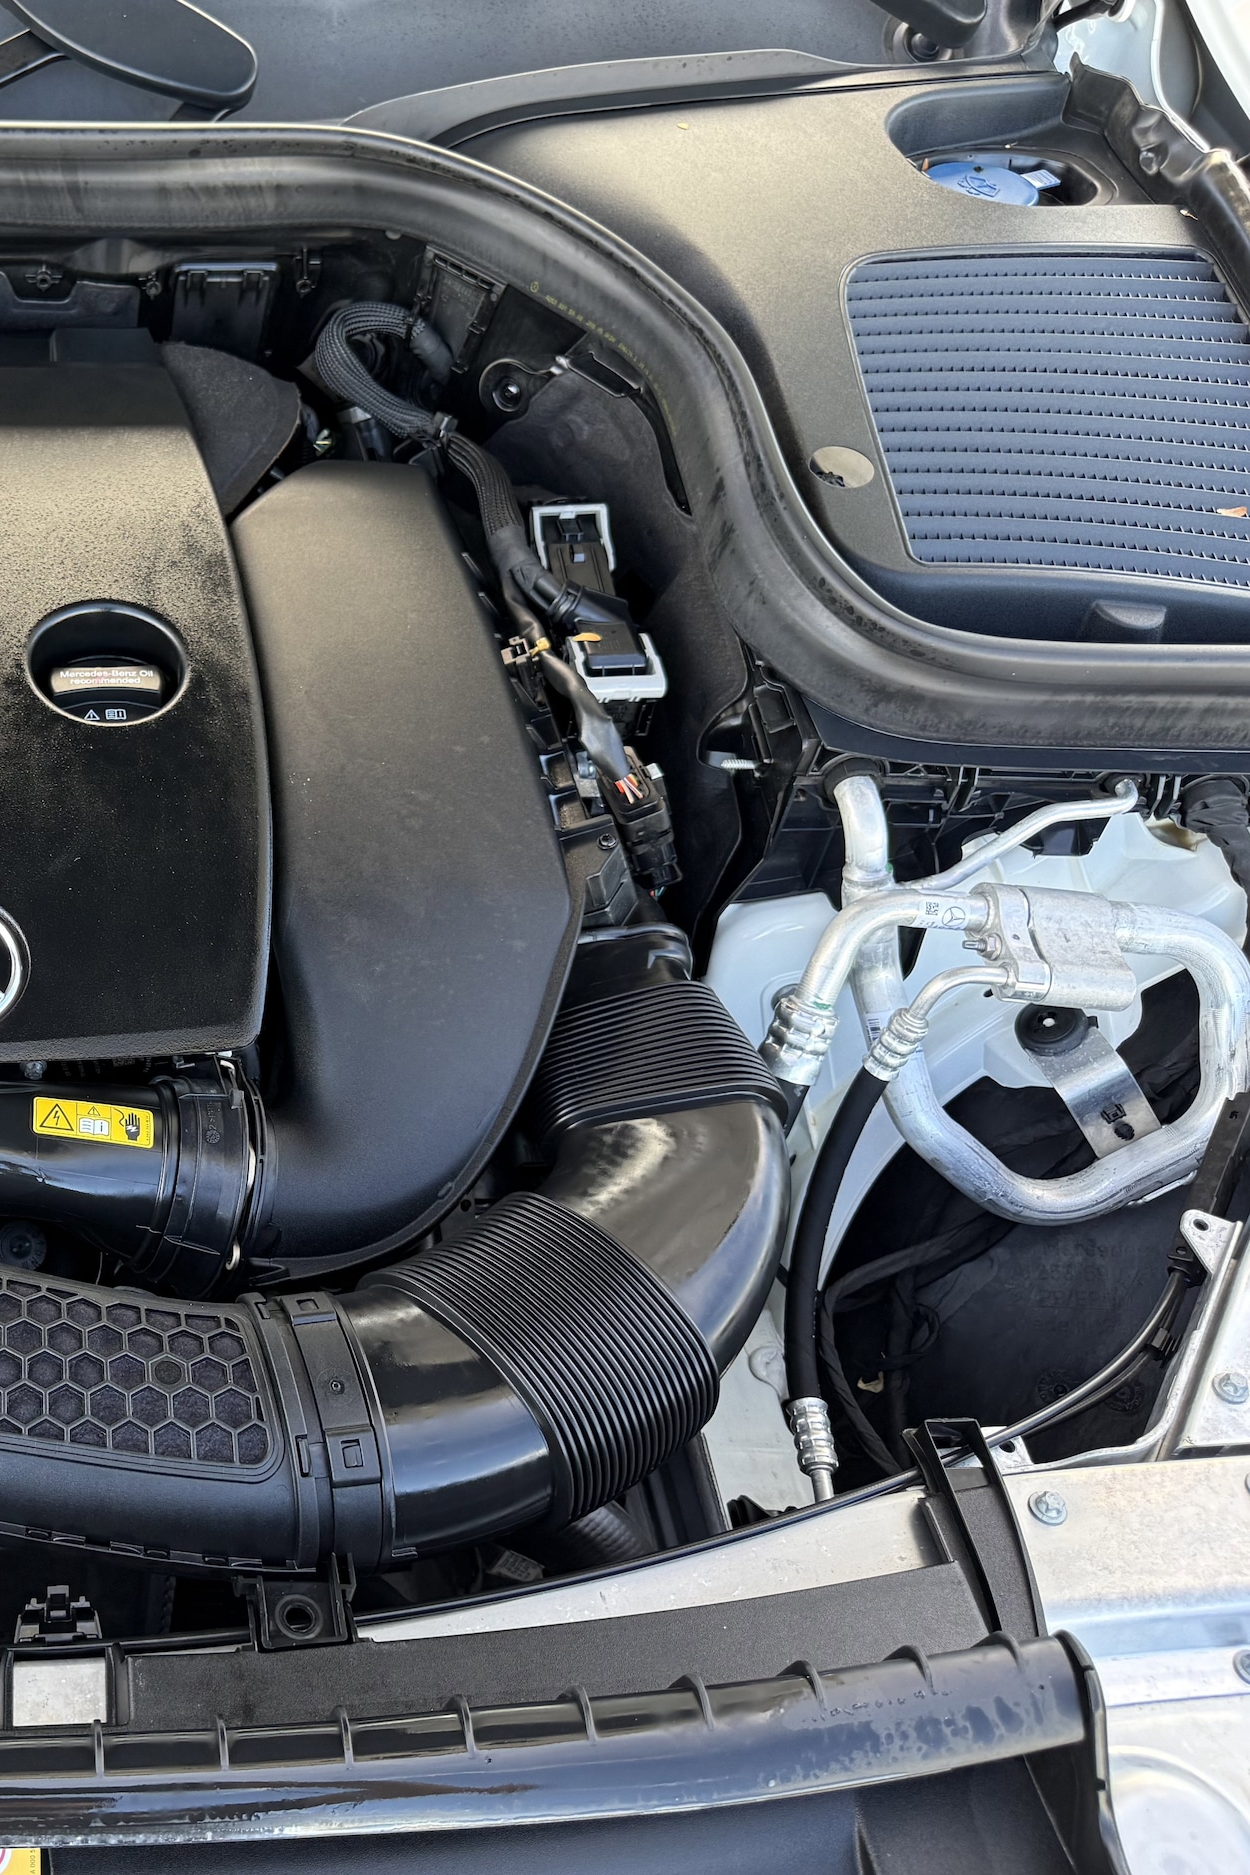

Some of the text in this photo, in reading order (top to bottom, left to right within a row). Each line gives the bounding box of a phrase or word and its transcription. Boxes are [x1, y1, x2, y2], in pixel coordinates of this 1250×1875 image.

[60, 669, 154, 678] Mercedes-Benz Oil
[70, 677, 141, 685] recommended
